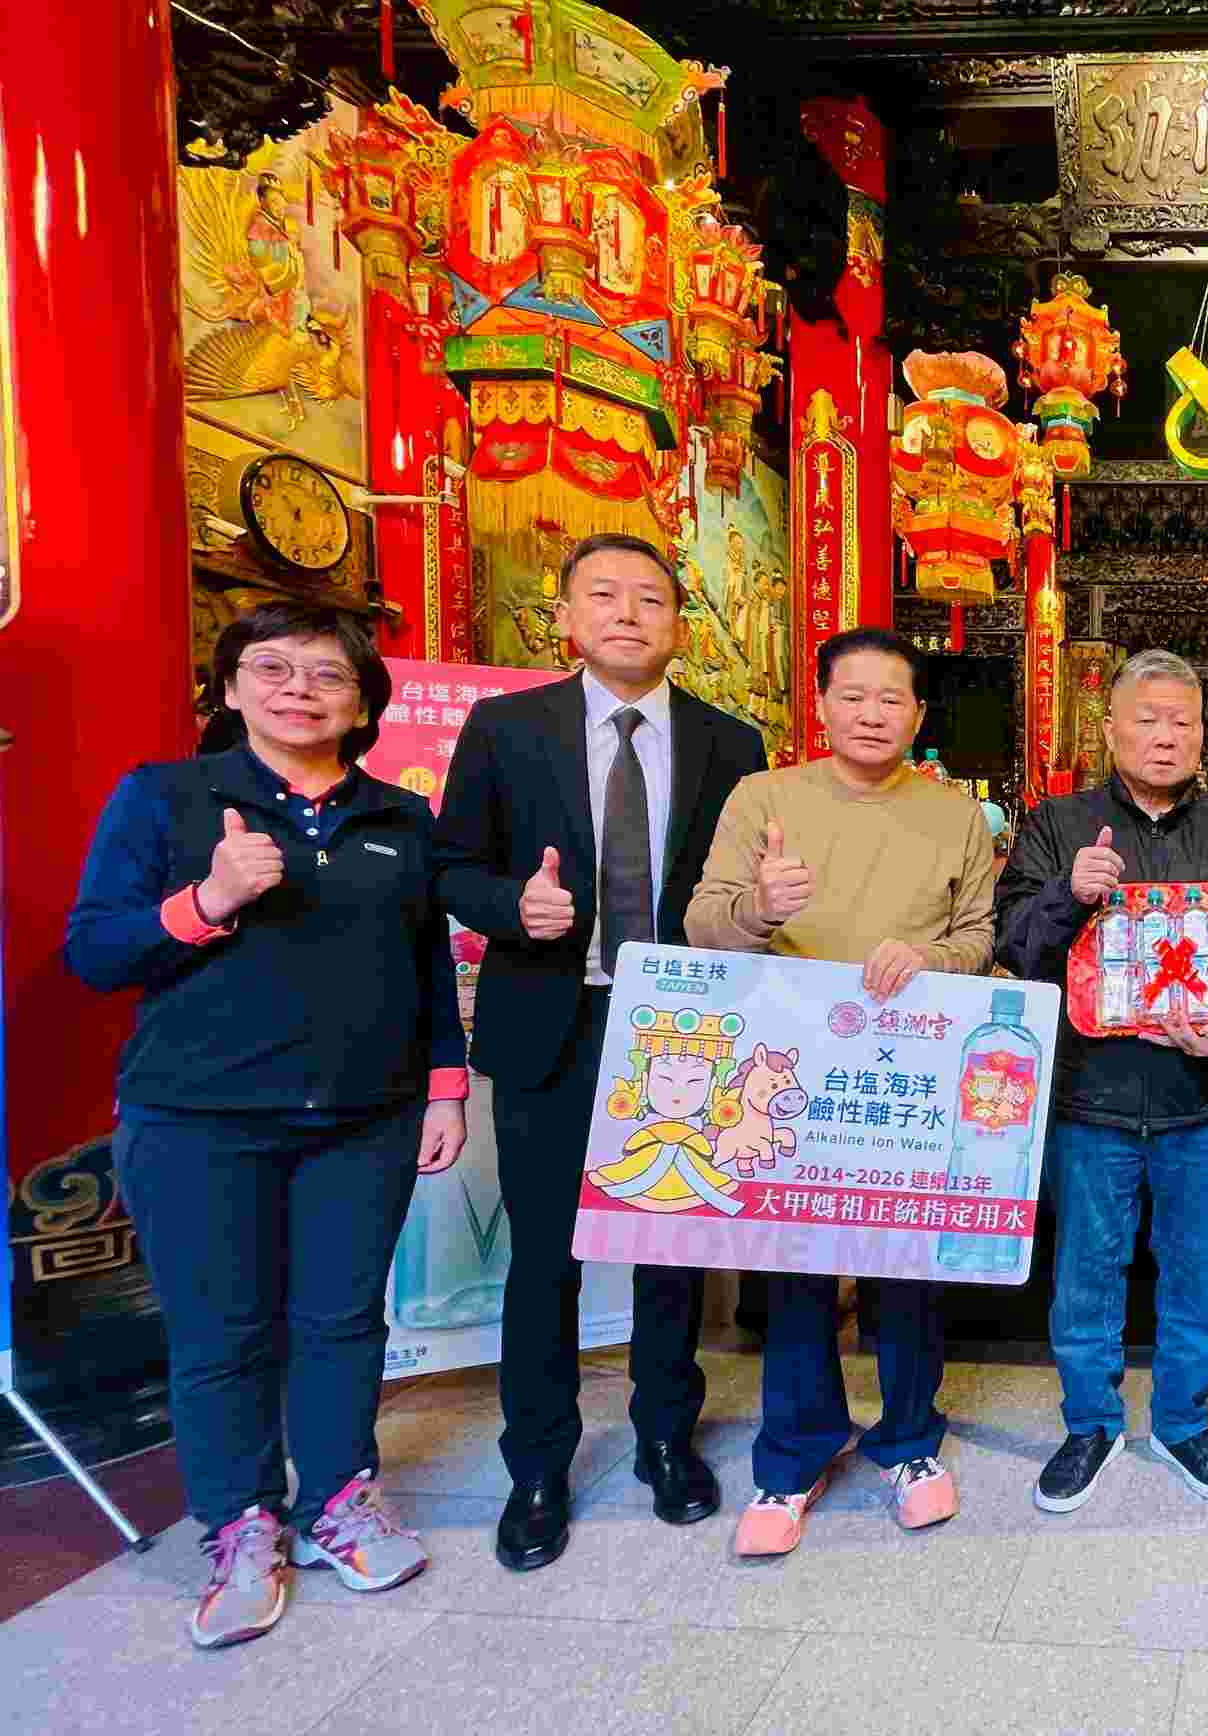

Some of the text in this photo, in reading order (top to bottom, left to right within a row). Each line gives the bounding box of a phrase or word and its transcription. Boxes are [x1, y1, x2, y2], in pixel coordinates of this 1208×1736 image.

[824, 1067, 938, 1099] 台塩海洋
[807, 1096, 947, 1130] 鹼性離子水
[805, 1130, 865, 1147] Alkaline
[900, 1137, 944, 1152] Water
[795, 1164, 906, 1187] 2014~2026
[752, 1187, 1028, 1231] 大甲媽祖正統指定用水
